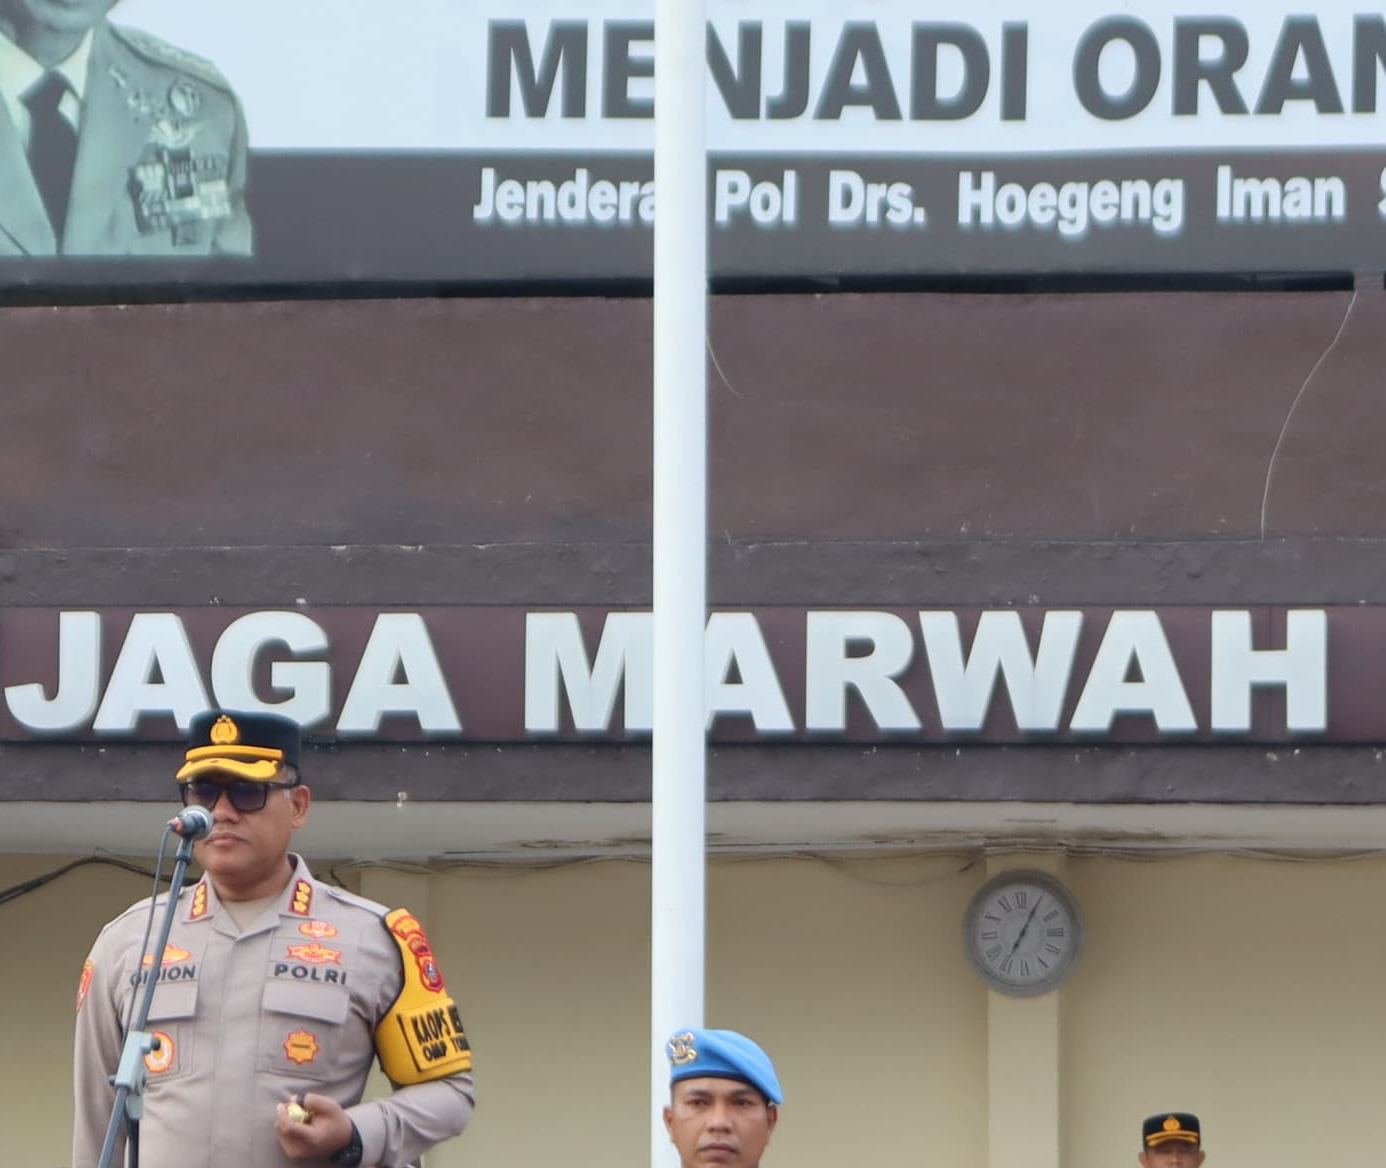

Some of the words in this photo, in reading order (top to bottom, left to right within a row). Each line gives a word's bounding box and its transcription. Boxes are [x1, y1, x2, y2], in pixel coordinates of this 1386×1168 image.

[485, 17, 1029, 121] MENJADI
[473, 167, 655, 223] Jendera
[715, 169, 796, 223] Pol
[828, 170, 926, 223] Drs.
[958, 172, 1184, 236] Hoegeng
[1216, 165, 1346, 218] Iman
[3, 609, 463, 734] JAGA
[525, 609, 1327, 734] MARWAH
[274, 963, 346, 985] POLRI
